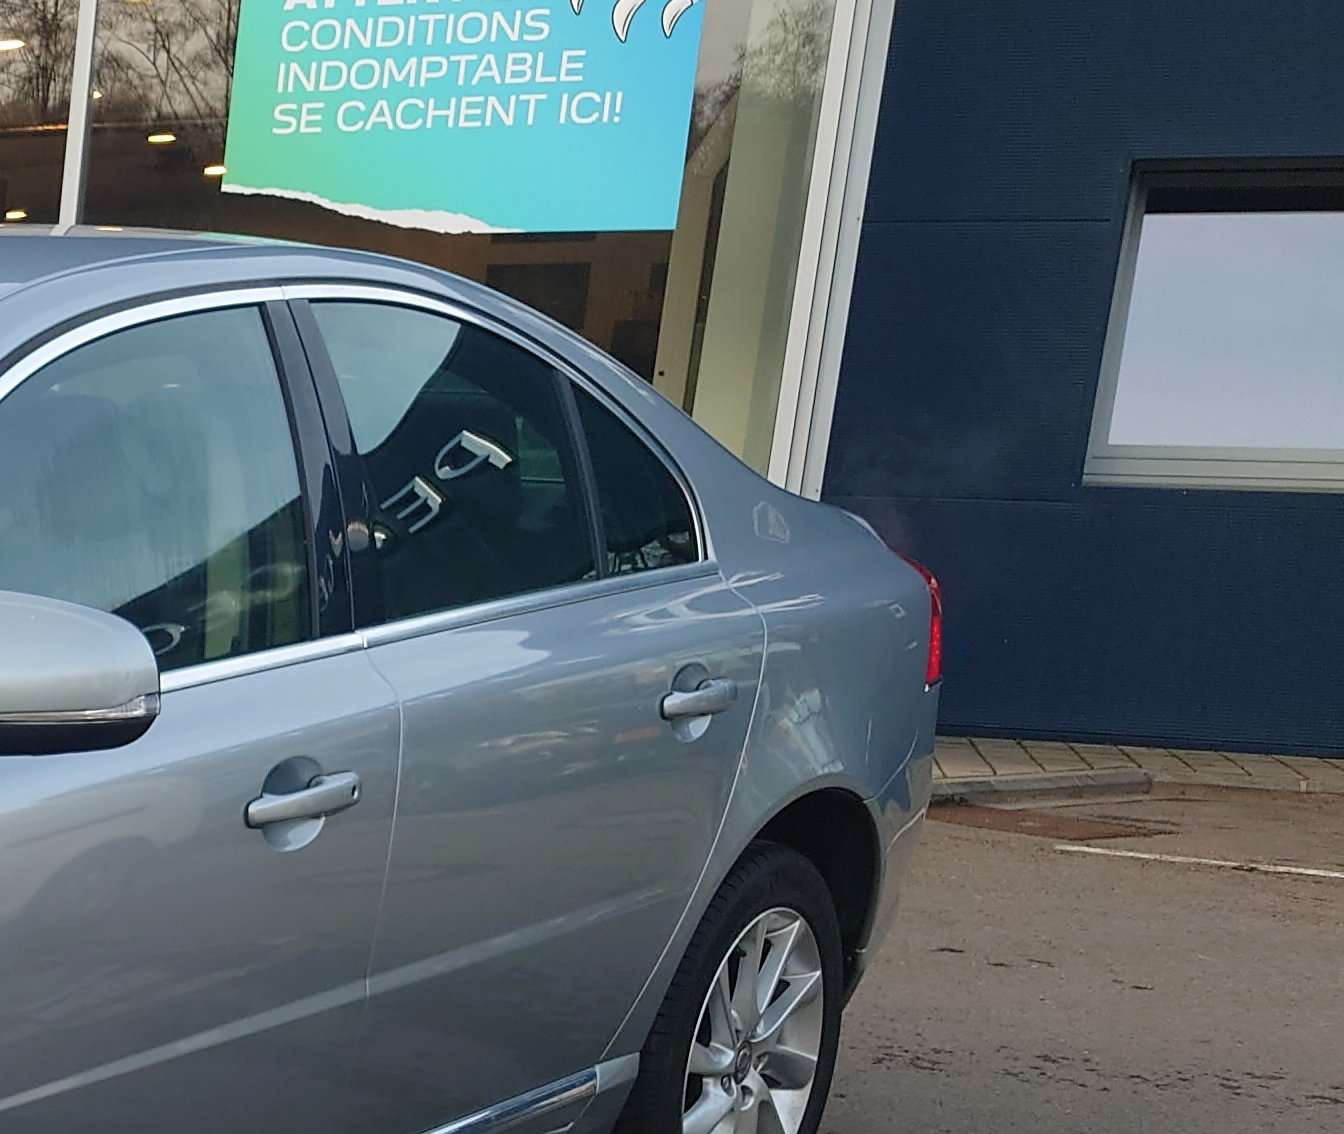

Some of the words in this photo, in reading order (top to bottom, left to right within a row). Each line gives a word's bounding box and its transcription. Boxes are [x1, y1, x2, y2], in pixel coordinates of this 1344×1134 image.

[280, 9, 551, 53] CONDITIONS
[276, 49, 586, 94] INDOMPTABLE
[272, 102, 324, 135] SE
[336, 94, 547, 132] CACHENT
[559, 91, 623, 125] ICI!
